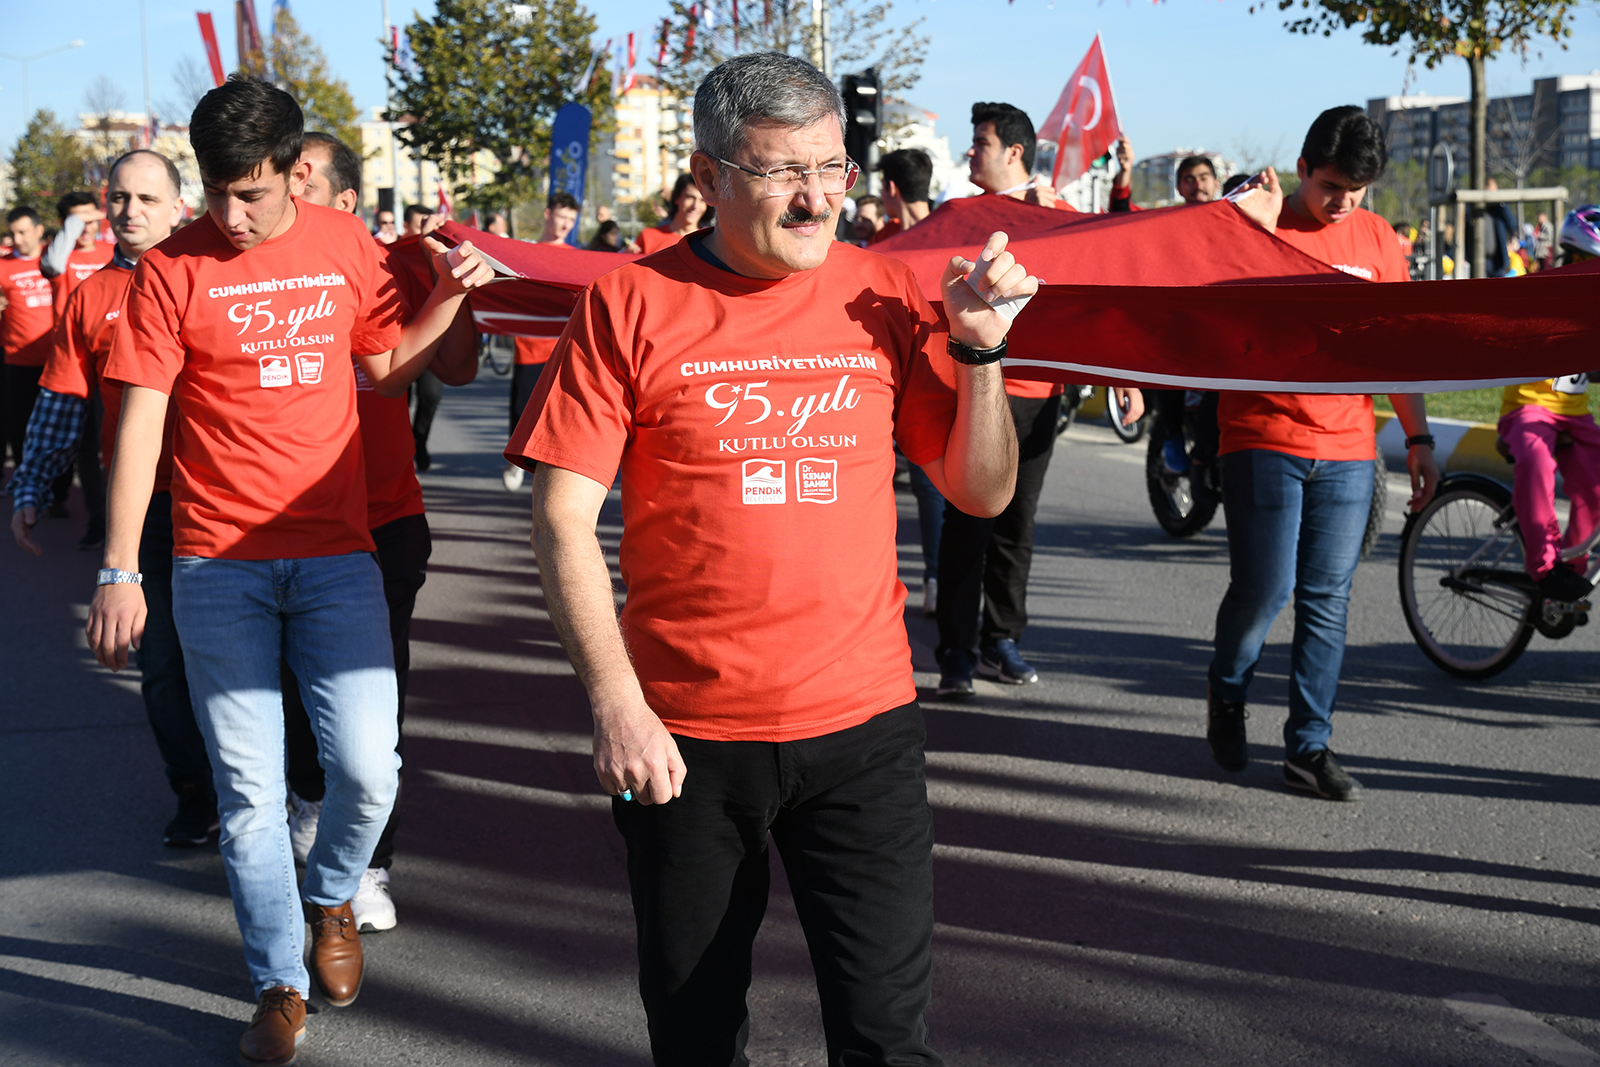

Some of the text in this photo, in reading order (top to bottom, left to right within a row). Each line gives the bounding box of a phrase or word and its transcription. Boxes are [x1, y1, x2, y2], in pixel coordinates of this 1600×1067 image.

[208, 272, 346, 299] CUMHURİYETİMİZİN
[240, 333, 335, 354] KUTLU OLSUN
[680, 353, 878, 377] CUMHURİYETİMİZİN
[718, 434, 857, 454] KUTLU OLSUN
[802, 464, 814, 473] Dr.
[802, 472, 832, 481] KENAN
